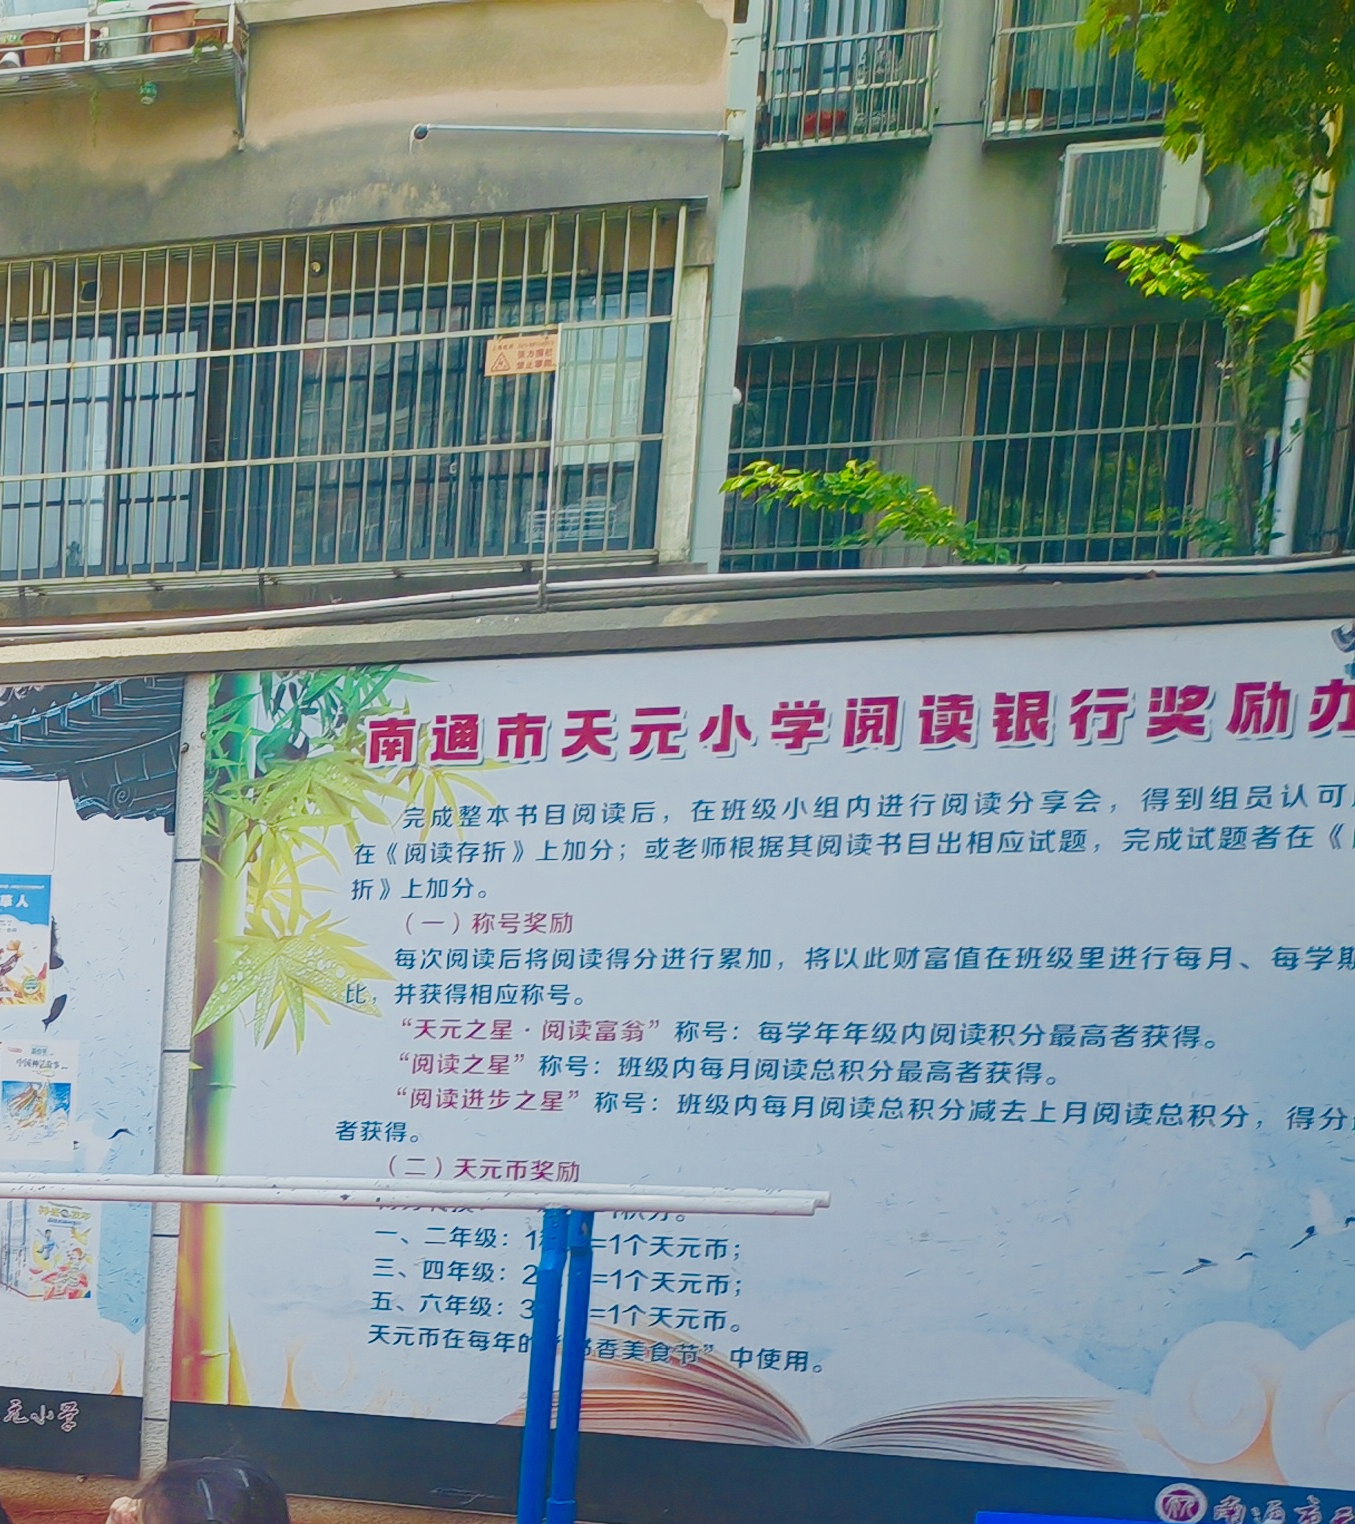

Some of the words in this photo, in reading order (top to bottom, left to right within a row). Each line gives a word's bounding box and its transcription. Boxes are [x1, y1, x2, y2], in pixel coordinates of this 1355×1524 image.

[402, 783, 1355, 829] 完成整本书目阅读后，在班级小组内进行阅读分享会，得到组员认可
[354, 823, 1355, 866] 在《阅读存折》上加分；或老师根据其阅读书目出相应试题，完成试题者在《
[351, 877, 490, 901] 折》上加分。
[404, 911, 574, 936] （一）称号奖励
[344, 982, 585, 1006] 比，并获得相应称号。
[396, 1087, 1355, 1133] “阅读进步之星”称号：班级内每月阅读总积分减去上月阅读总积分，得分
[335, 1120, 420, 1144] 者获得。
[387, 1155, 580, 1183] （二）天元币奖励
[374, 1225, 741, 1260] 一、二年级：1=1个天元币；
[372, 1257, 741, 1297] 三、四年级：2=1个天元币；
[371, 1290, 741, 1334] 五、六年级：3=1个天元币。
[367, 1323, 826, 1374] 天元币在每年的香美食节”中使用。
